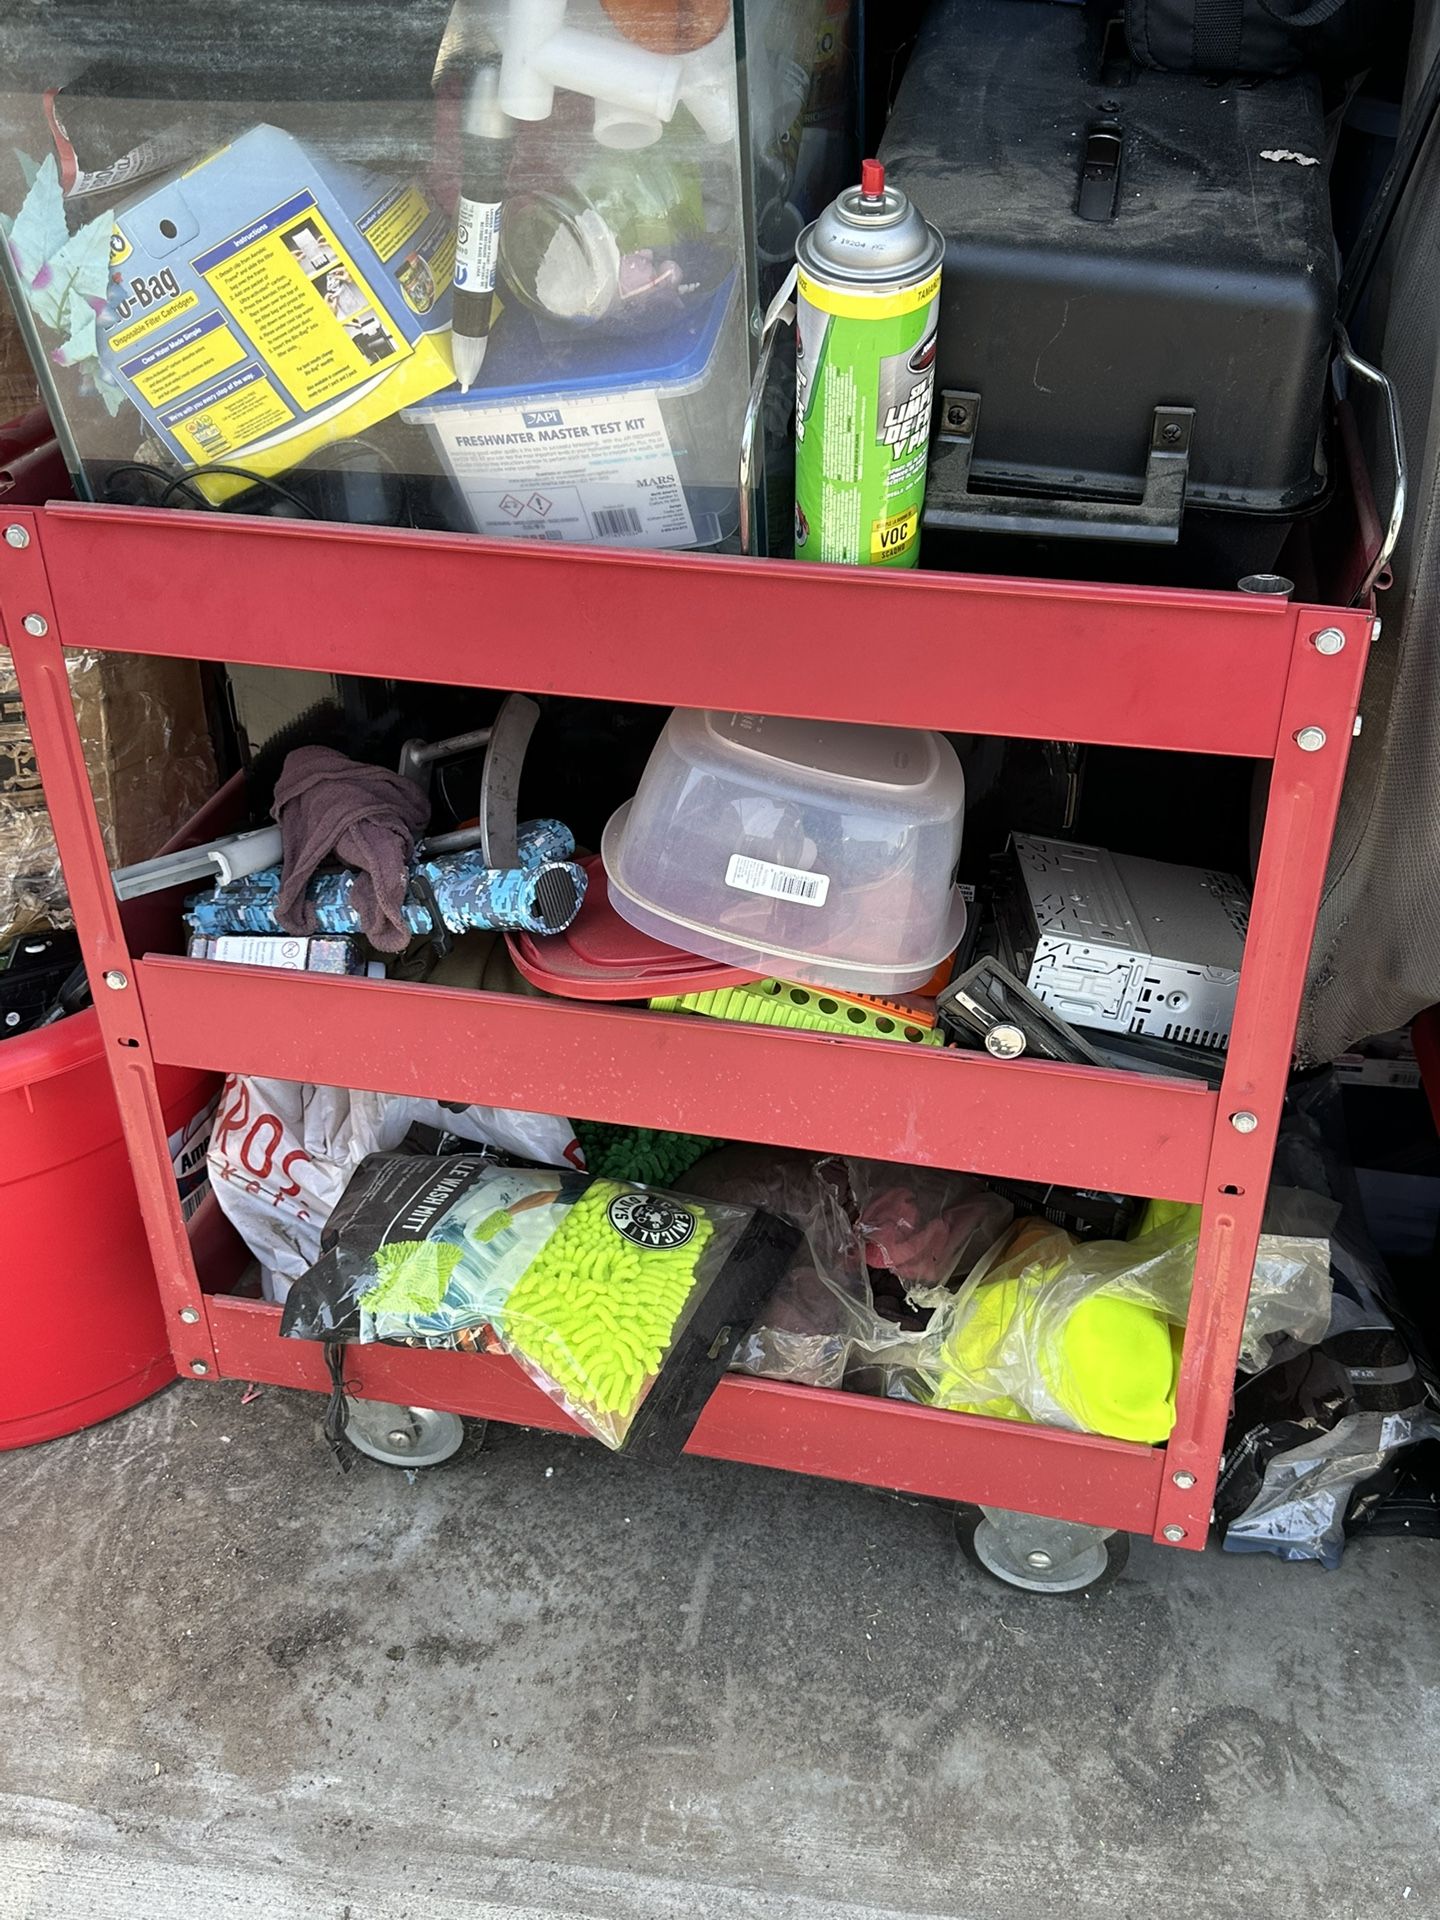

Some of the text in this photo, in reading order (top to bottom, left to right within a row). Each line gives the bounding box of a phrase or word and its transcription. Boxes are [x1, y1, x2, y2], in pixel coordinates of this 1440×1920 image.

[233, 224, 268, 247] Instructions
[264, 252, 274, 260] filter
[106, 266, 181, 331] o-Bag
[260, 303, 270, 312] down
[113, 296, 194, 347] Disposable Filter Cartridges
[267, 318, 278, 326] down
[275, 323, 286, 331] under
[141, 354, 155, 364] Clear
[168, 338, 184, 349] Made
[183, 328, 202, 341] Simple
[182, 406, 194, 414] with
[193, 401, 203, 410] you
[202, 394, 217, 404] every
[216, 387, 228, 397] step
[233, 379, 243, 387] the
[242, 373, 254, 382] way.
[528, 412, 557, 424] API
[885, 390, 932, 427] LIMP
[455, 418, 645, 447] FRESHWATER MASTER TEST KIT
[636, 474, 675, 488] MARS
[881, 523, 908, 548] VOC
[422, 1178, 463, 1205] WASH
[402, 1205, 437, 1232] MITT
[614, 1195, 642, 1221] GUYS
